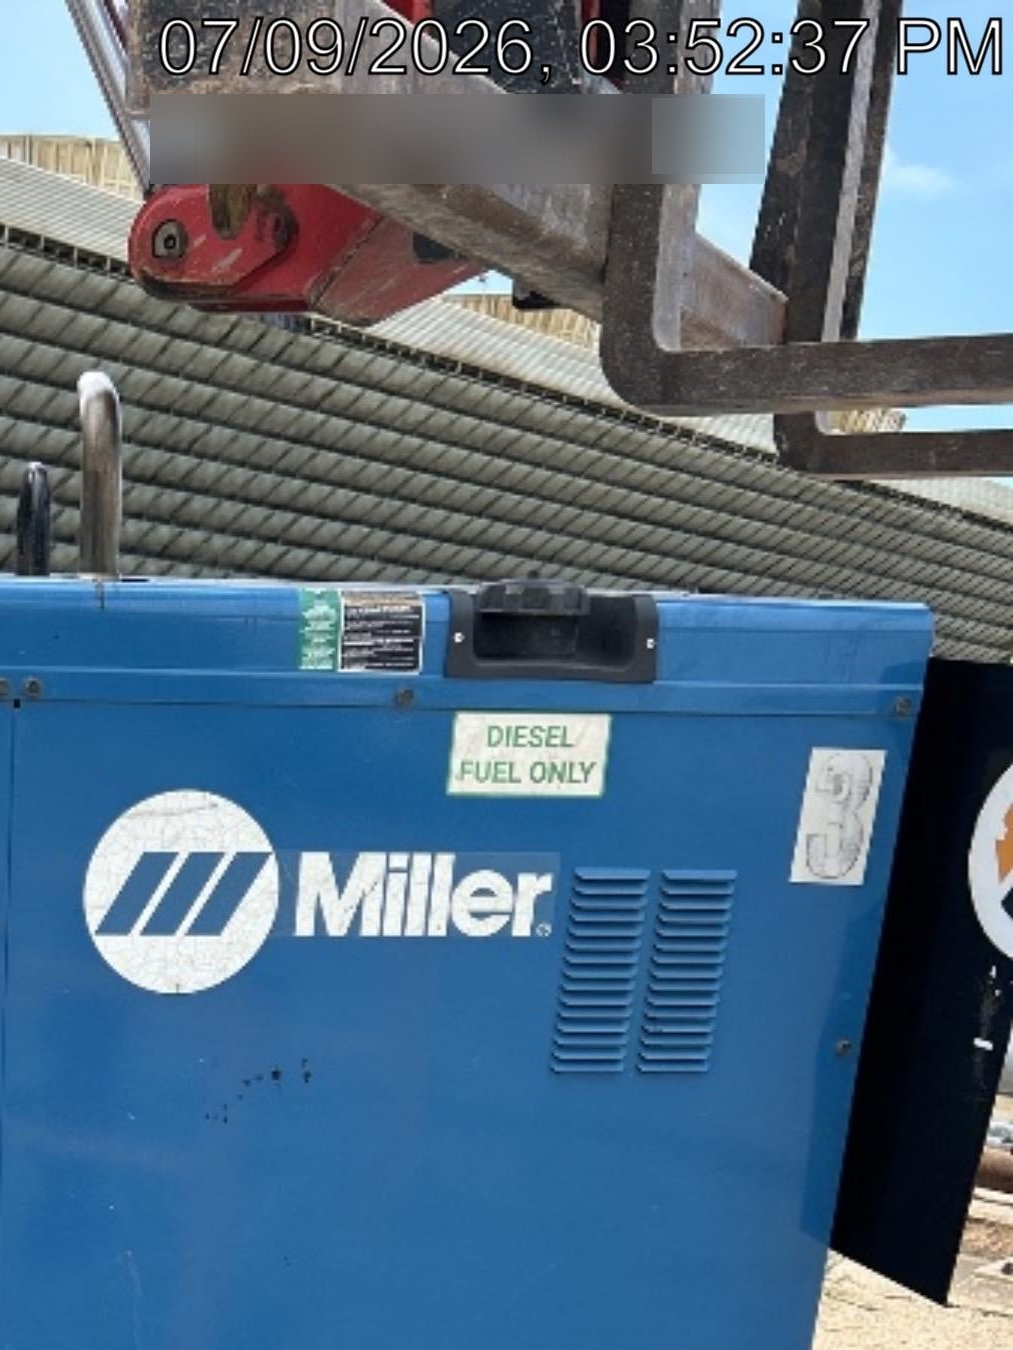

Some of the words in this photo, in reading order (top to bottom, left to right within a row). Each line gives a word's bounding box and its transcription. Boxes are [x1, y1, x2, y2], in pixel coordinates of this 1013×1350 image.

[487, 725, 575, 749] DIESEL
[456, 761, 523, 784] FUEL
[529, 761, 597, 785] ONLY
[806, 753, 874, 878] 3
